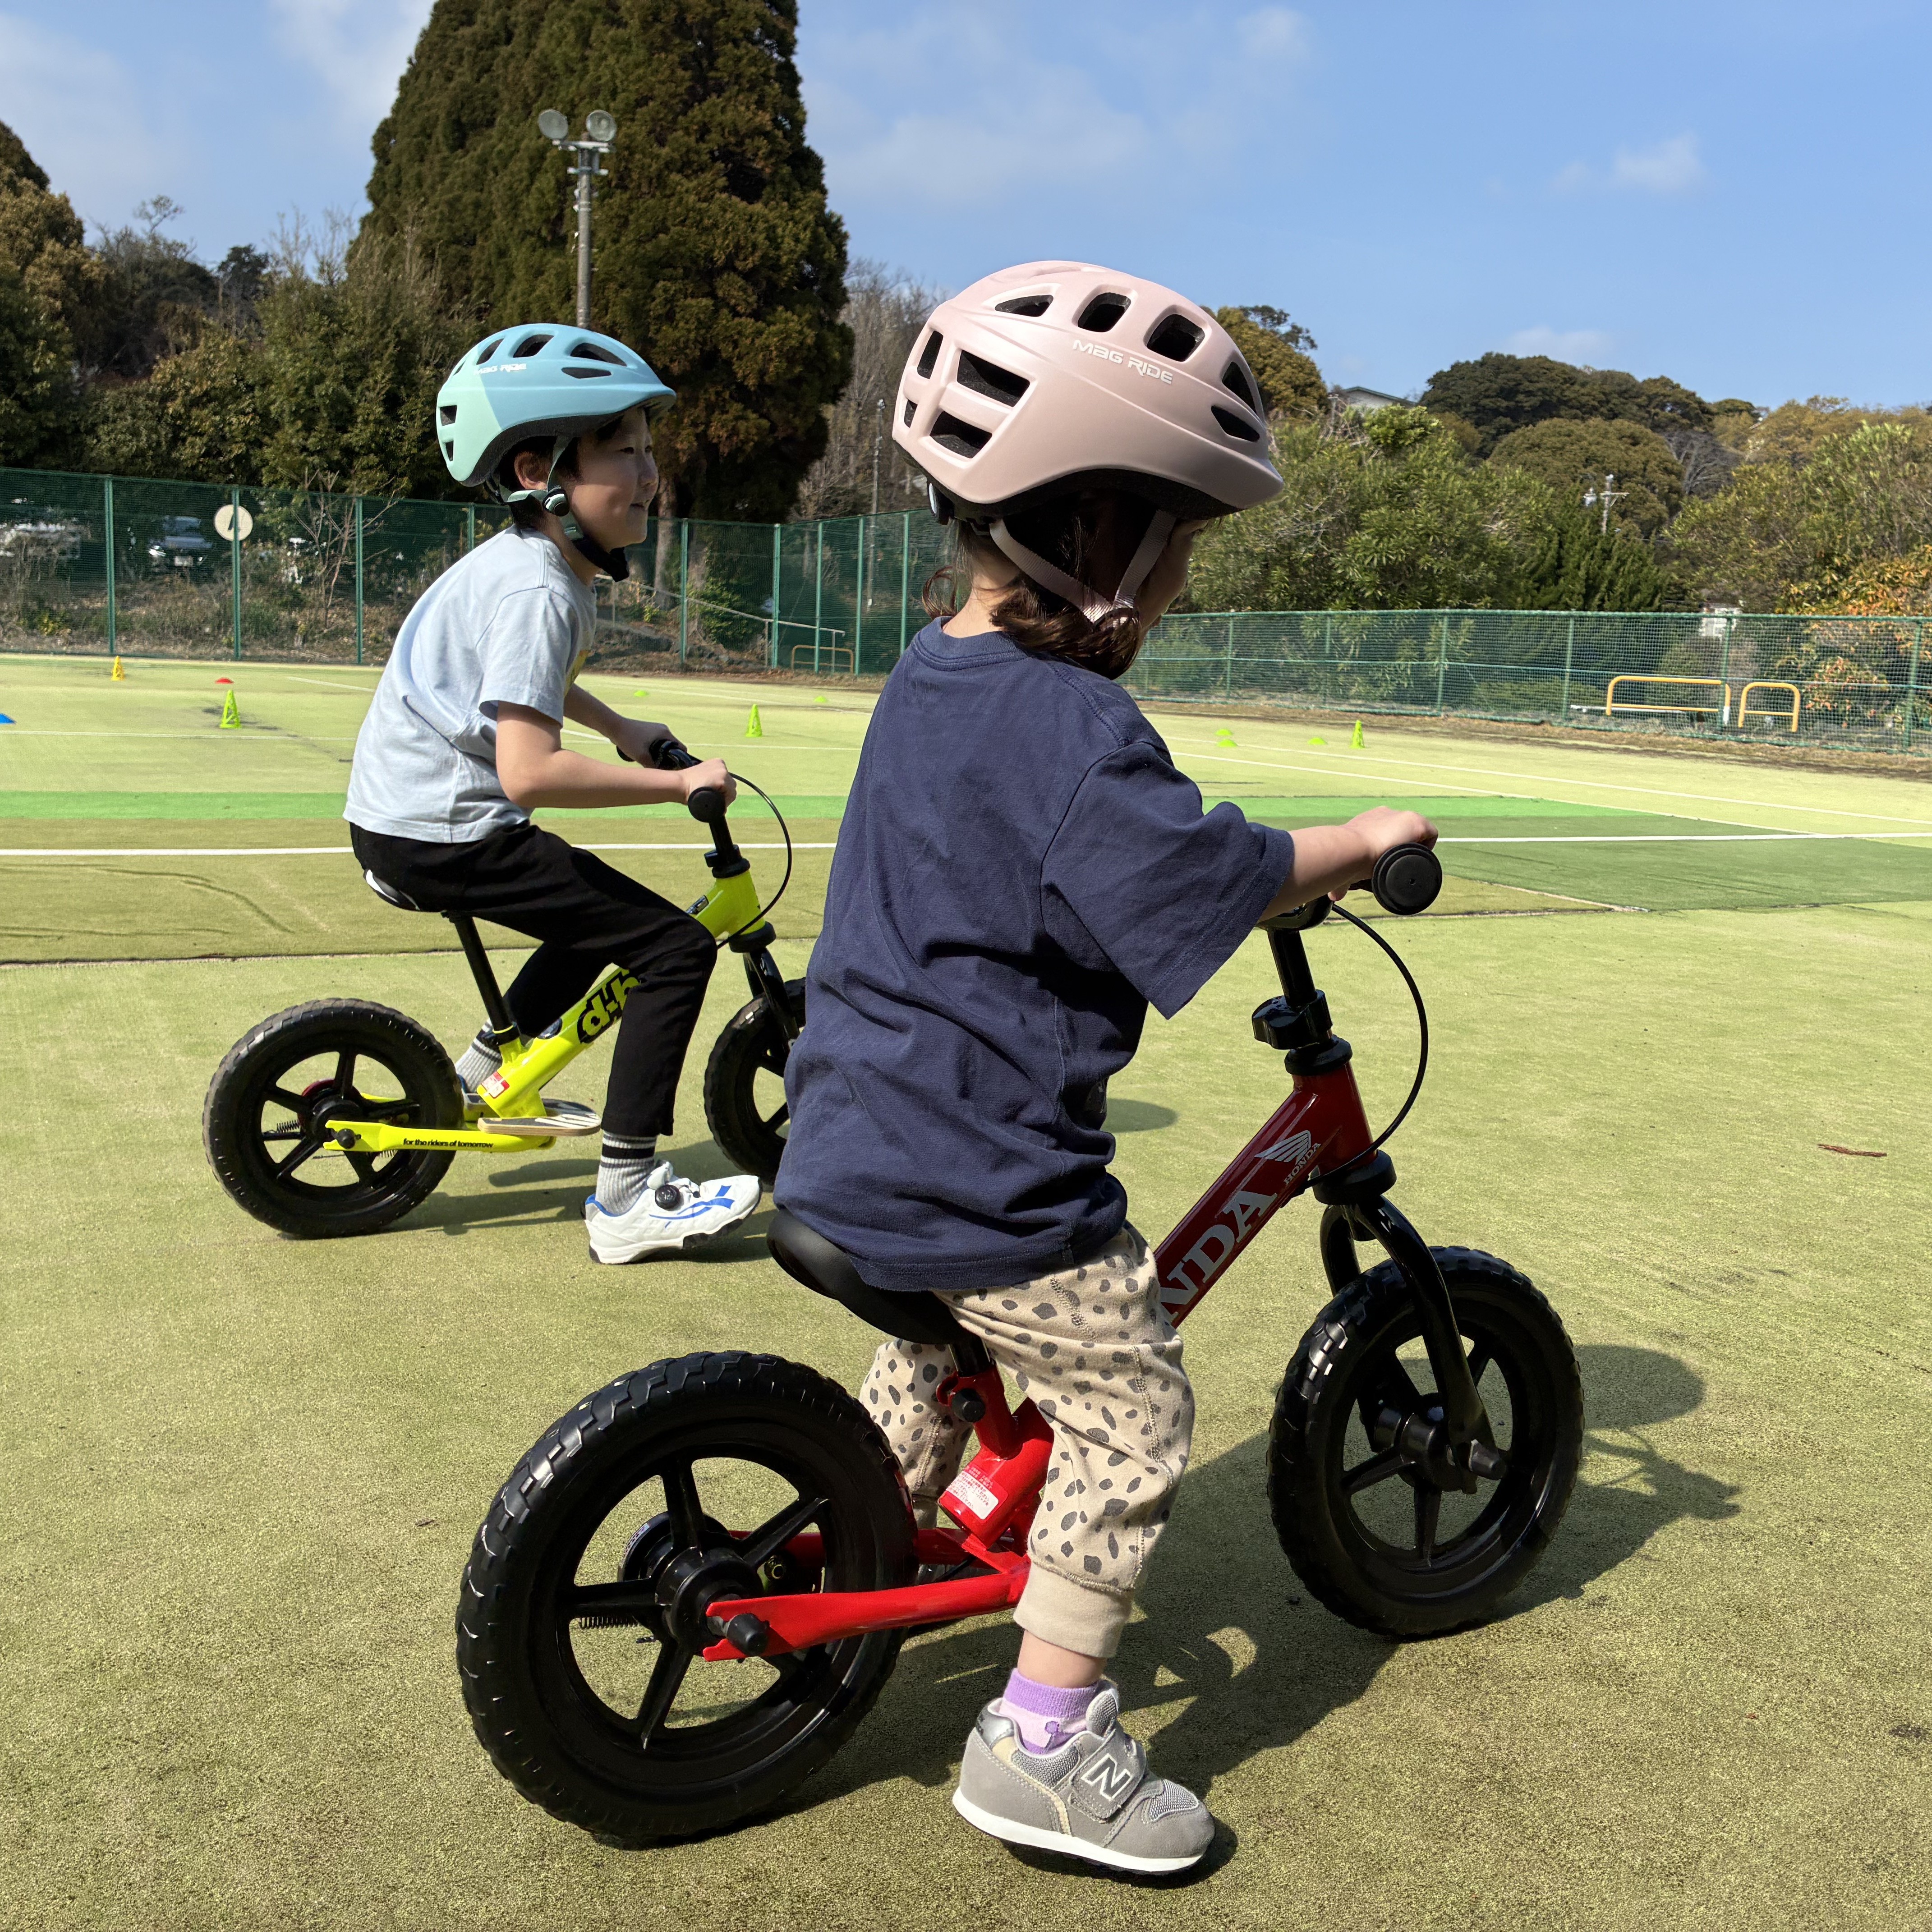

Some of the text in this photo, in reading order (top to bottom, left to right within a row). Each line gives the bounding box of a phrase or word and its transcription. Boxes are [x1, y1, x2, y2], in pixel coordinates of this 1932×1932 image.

[1127, 357, 1173, 385] RIDE
[1283, 1143, 1321, 1185] HONDA
[1080, 1753, 1134, 1801] N
